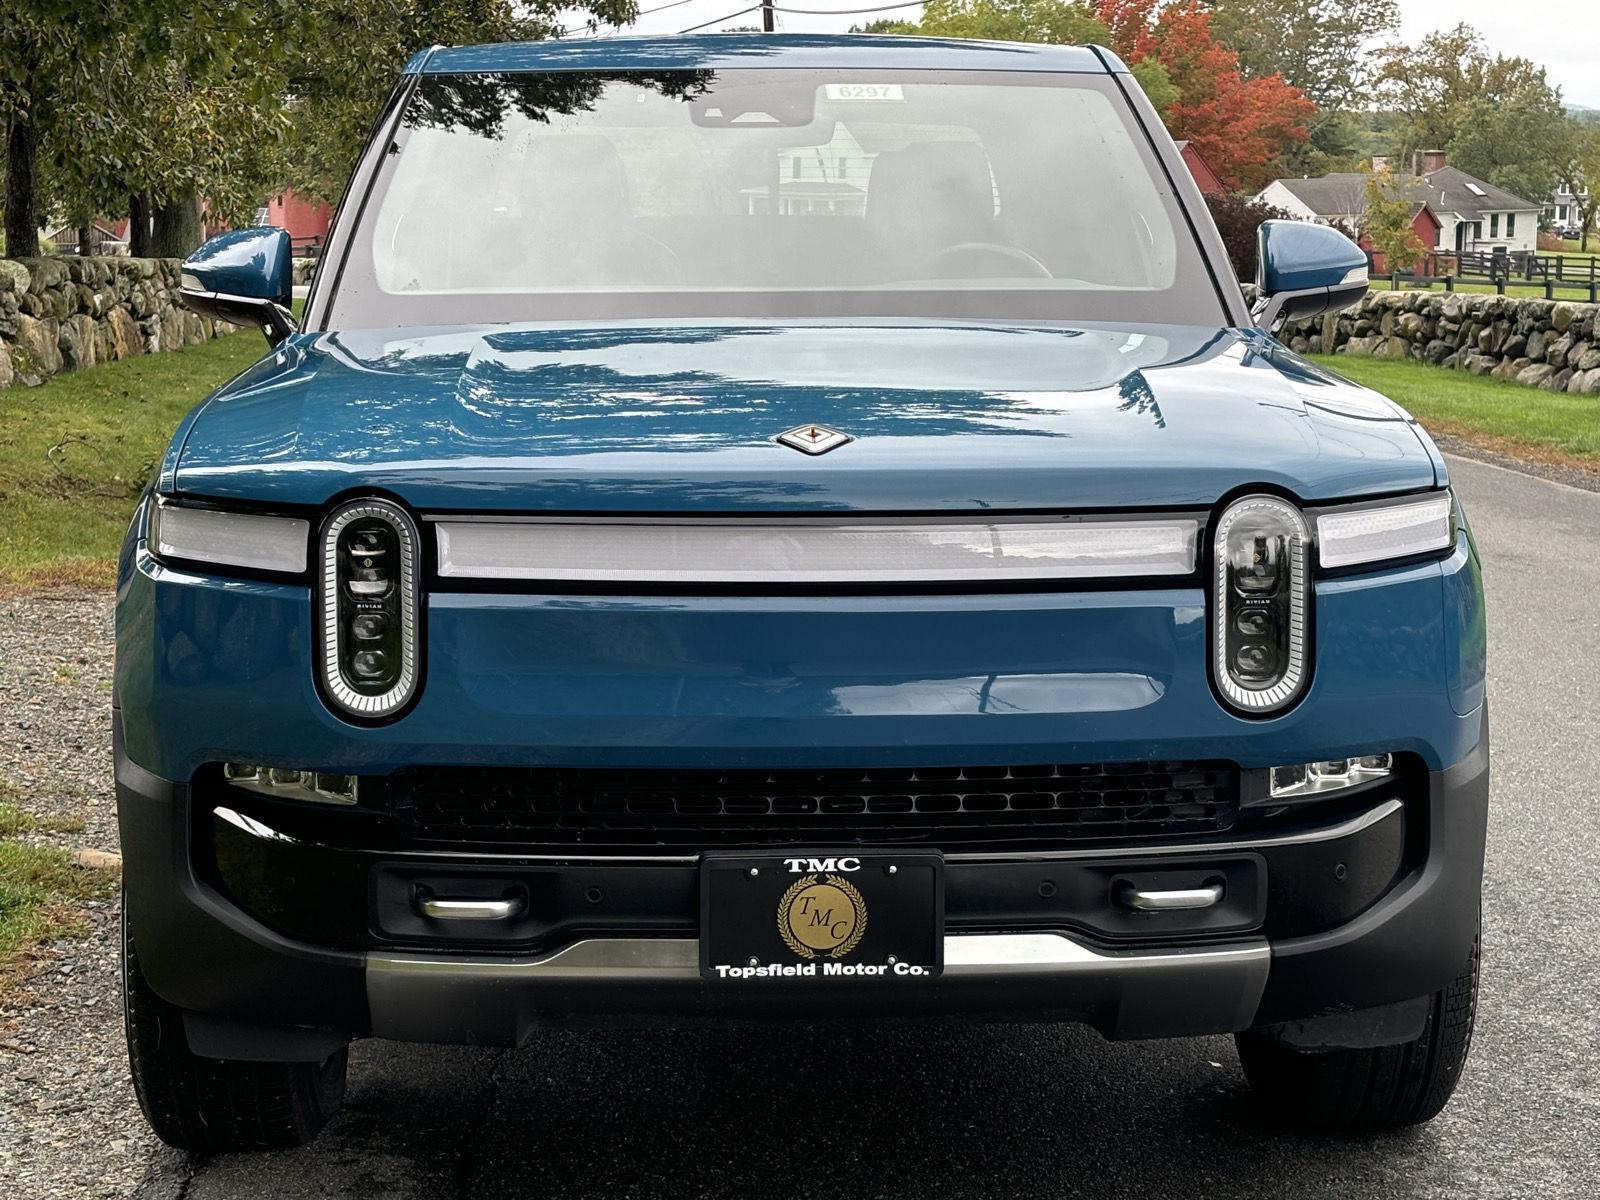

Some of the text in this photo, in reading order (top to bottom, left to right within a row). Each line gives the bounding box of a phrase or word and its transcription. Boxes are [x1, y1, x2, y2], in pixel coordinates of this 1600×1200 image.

[839, 86, 890, 98] 6297
[784, 858, 861, 872] TMC
[715, 962, 930, 978] Topsfield Motor Co.
